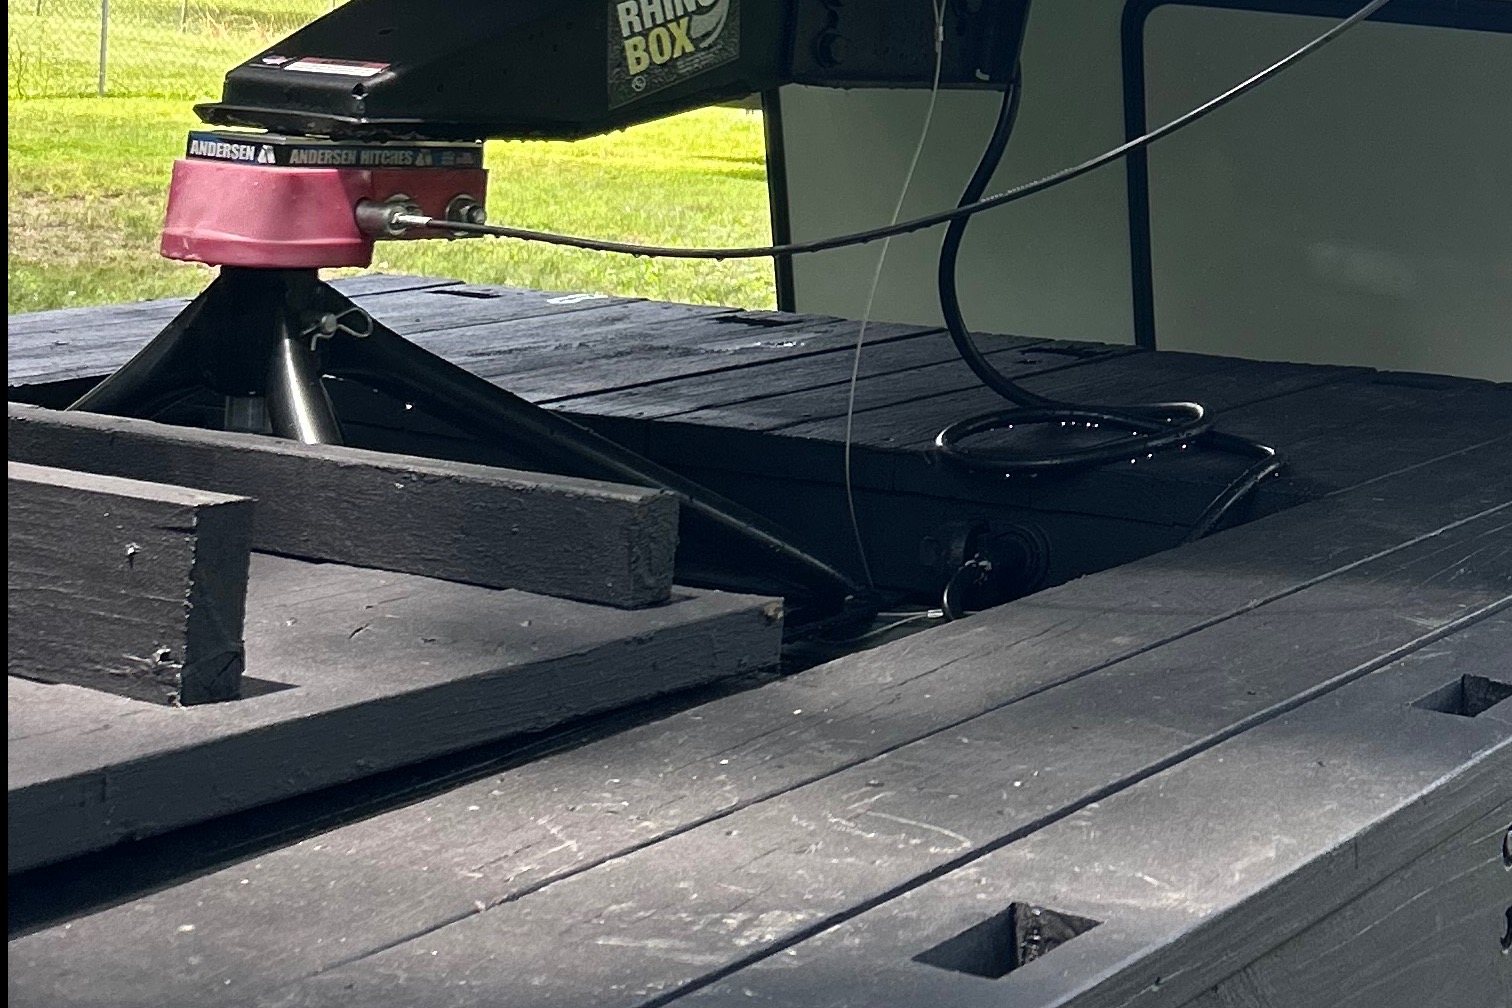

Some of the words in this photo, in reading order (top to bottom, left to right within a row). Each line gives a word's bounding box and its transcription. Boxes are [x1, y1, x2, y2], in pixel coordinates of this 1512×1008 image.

[624, 16, 696, 75] BOX
[189, 140, 255, 163] ANDERSEN
[289, 149, 356, 165] ANDERSEN
[360, 149, 413, 165] HITCHES
